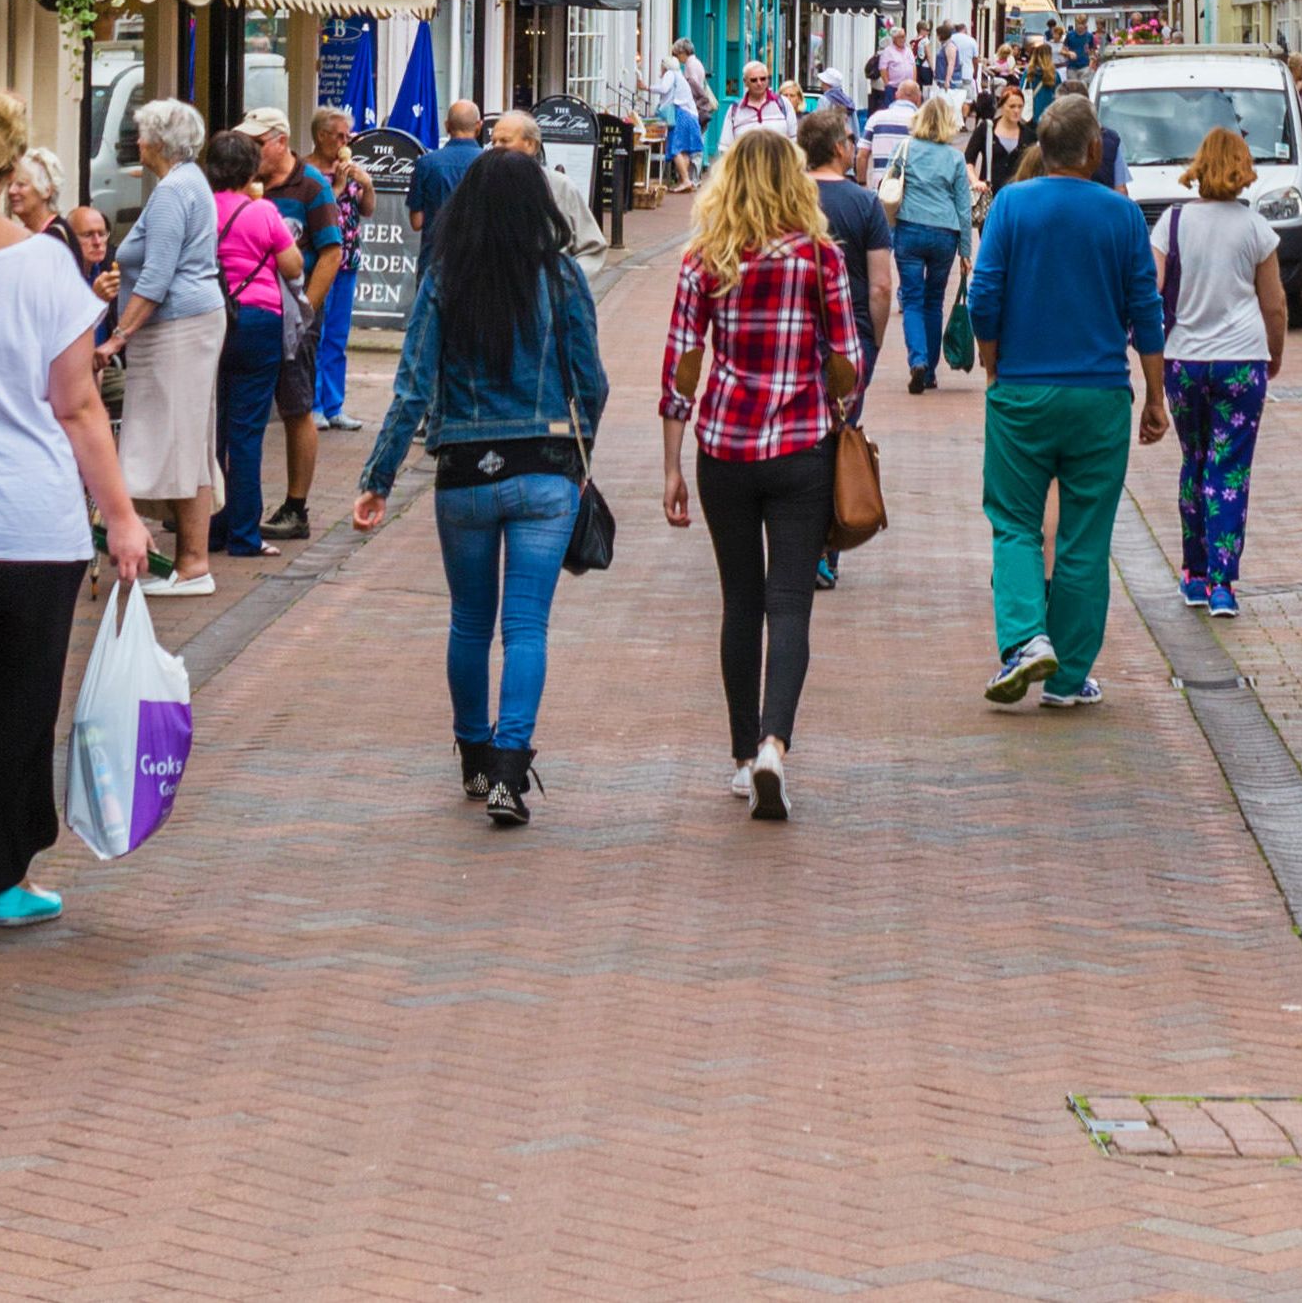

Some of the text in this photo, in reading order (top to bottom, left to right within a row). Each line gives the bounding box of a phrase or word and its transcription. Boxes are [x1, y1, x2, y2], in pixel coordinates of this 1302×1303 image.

[554, 106, 570, 114] THE
[373, 144, 394, 155] THE
[360, 223, 404, 244] EER
[358, 253, 418, 274] RDEN
[353, 282, 402, 304] PEN
